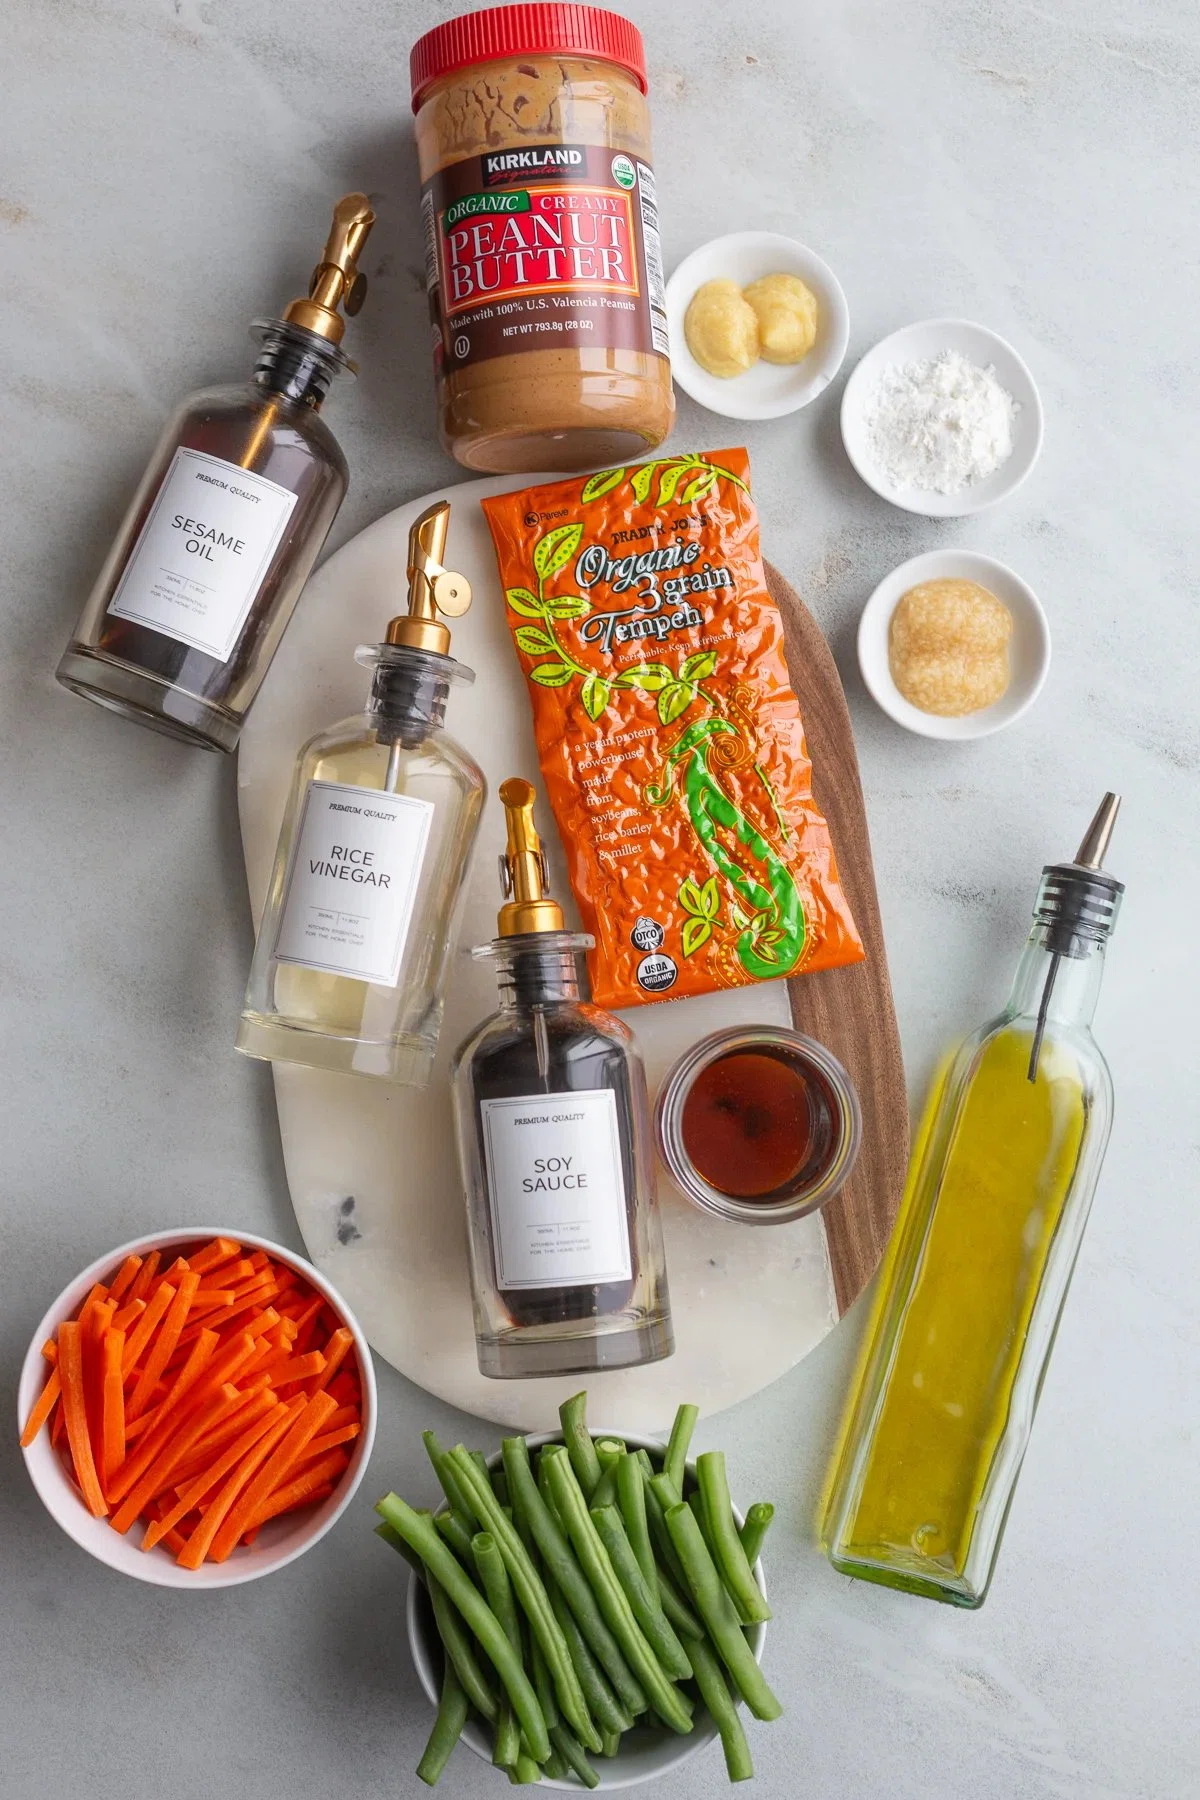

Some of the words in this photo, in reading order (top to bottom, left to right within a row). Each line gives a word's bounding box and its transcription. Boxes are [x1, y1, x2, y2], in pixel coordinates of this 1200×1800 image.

[487, 150, 582, 173] KIRKLAND
[447, 195, 519, 223] ORGANIC
[540, 196, 619, 212] CREAMY
[448, 212, 626, 267] PEANUT
[451, 246, 628, 301] BUTTER
[449, 315, 471, 331] Made
[473, 309, 494, 323] with
[496, 301, 524, 316] 100%
[526, 299, 549, 310] U.S.
[552, 296, 598, 308] Valencia
[599, 297, 636, 311] Peanuts
[503, 325, 519, 337] NET
[520, 323, 533, 333] WT
[534, 321, 563, 332] 793.8g
[565, 320, 578, 331] (28
[579, 320, 593, 330] OZ)
[195, 472, 229, 490] PREMIUM
[229, 486, 262, 504] QUALITY
[540, 509, 569, 521] Pareve
[171, 514, 246, 555] SESAME
[611, 522, 666, 545] TRADER
[669, 514, 708, 531] JOS
[185, 539, 215, 562] OIL
[575, 537, 701, 593] Organic
[634, 571, 664, 614] 3
[662, 563, 733, 605] grain
[580, 601, 704, 653] Tempeh
[668, 642, 690, 652] Keep
[574, 744, 581, 752] a
[583, 737, 614, 751] vegan
[616, 726, 657, 746] protein
[578, 748, 643, 772] powerhouse
[582, 773, 612, 788] made
[586, 794, 613, 806] from
[328, 802, 362, 815] PREMIUM
[363, 809, 398, 822] QUALITY
[591, 808, 642, 825] soybeans,
[620, 823, 652, 837] barley
[330, 845, 375, 867] RICE
[599, 849, 609, 860] &
[611, 843, 643, 858] millet
[309, 859, 391, 889] VINEGAR
[636, 929, 657, 941] OTCO
[644, 961, 668, 974] USDA
[644, 972, 673, 984] ORGANIC
[514, 1115, 549, 1126] PREMIUM
[551, 1113, 585, 1123] QUALITY
[534, 1156, 573, 1173] SOY
[522, 1173, 588, 1193] SAUCE
